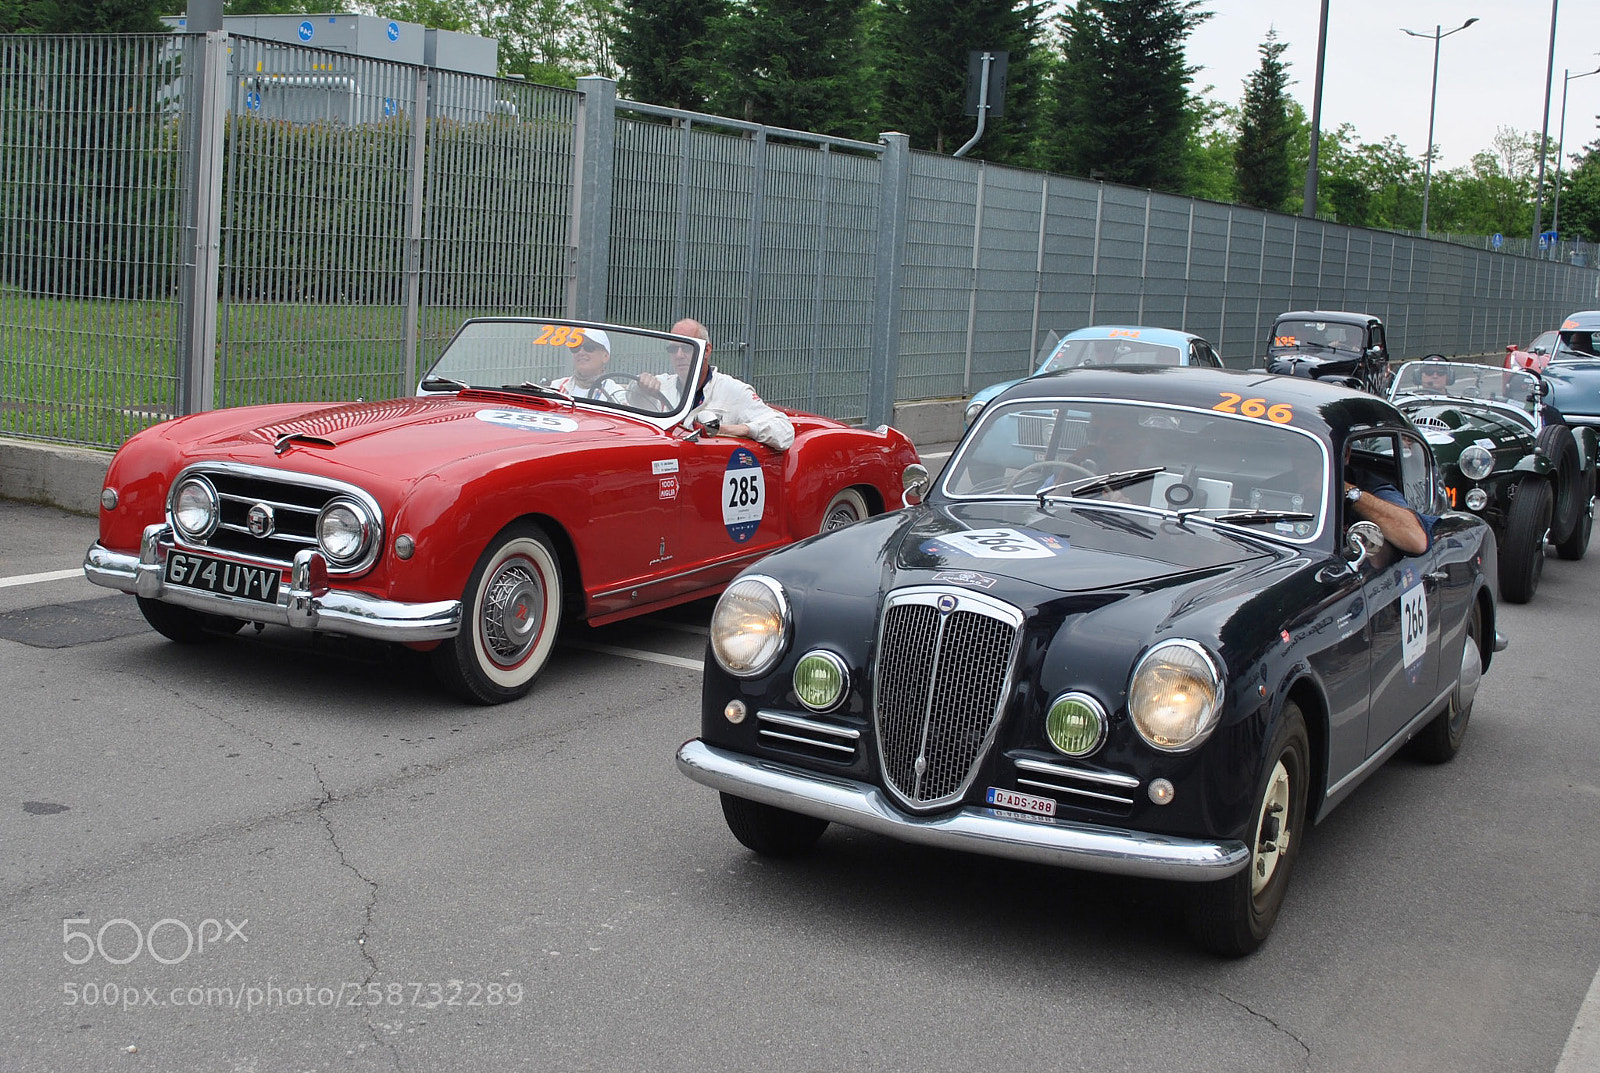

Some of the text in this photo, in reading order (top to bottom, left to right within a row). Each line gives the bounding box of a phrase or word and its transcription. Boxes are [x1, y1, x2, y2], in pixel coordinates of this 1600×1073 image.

[533, 325, 586, 349] 285
[493, 411, 562, 427] 285
[1212, 392, 1293, 425] 266
[728, 475, 759, 508] 285
[963, 531, 1038, 553] 266
[170, 554, 276, 600] 674 UYV
[1405, 594, 1424, 646] 266
